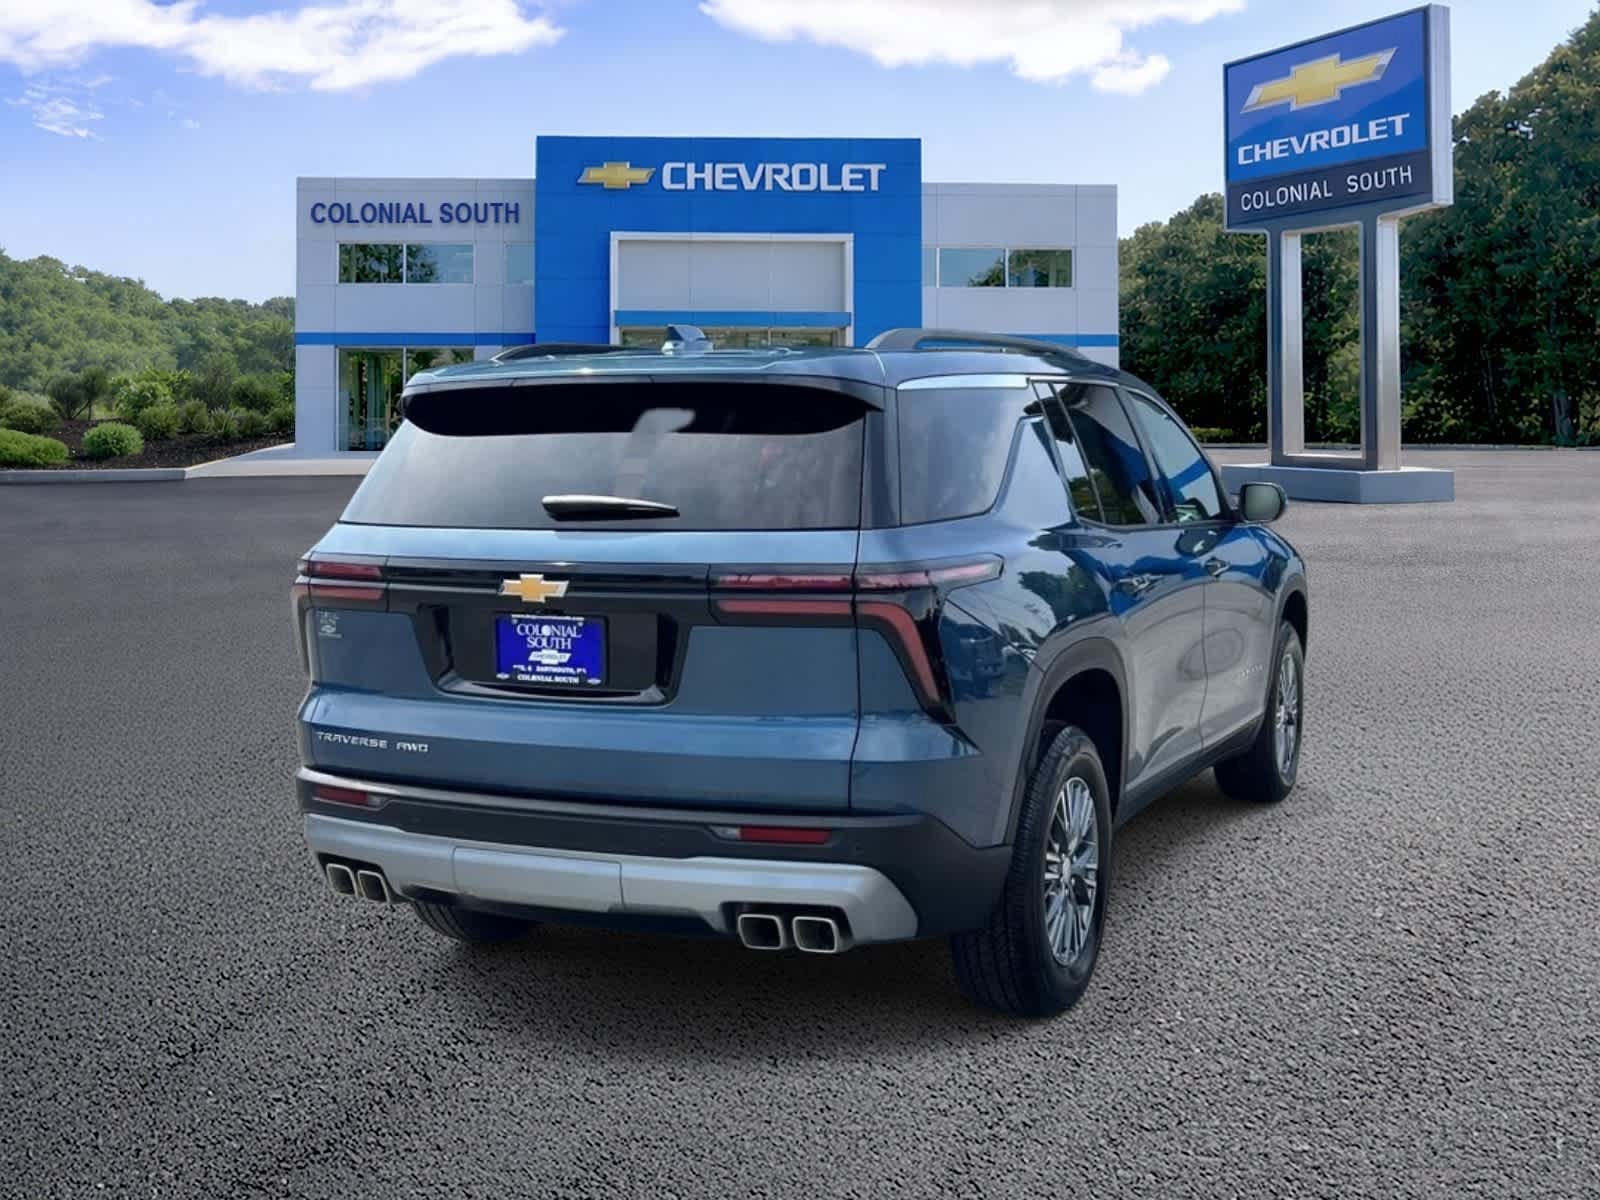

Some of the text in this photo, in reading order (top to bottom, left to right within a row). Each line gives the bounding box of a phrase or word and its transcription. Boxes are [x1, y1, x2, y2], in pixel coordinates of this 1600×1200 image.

[1237, 113, 1410, 165] CHEVROLET
[662, 161, 887, 192] CHEVROLET
[1240, 166, 1412, 211] COLONIAL SOUTH
[310, 202, 520, 224] COLONIAL SOUTH
[516, 623, 582, 638] COLONIAL
[526, 636, 572, 650] SOUTH
[316, 731, 429, 752] TRAVERSE AWD
